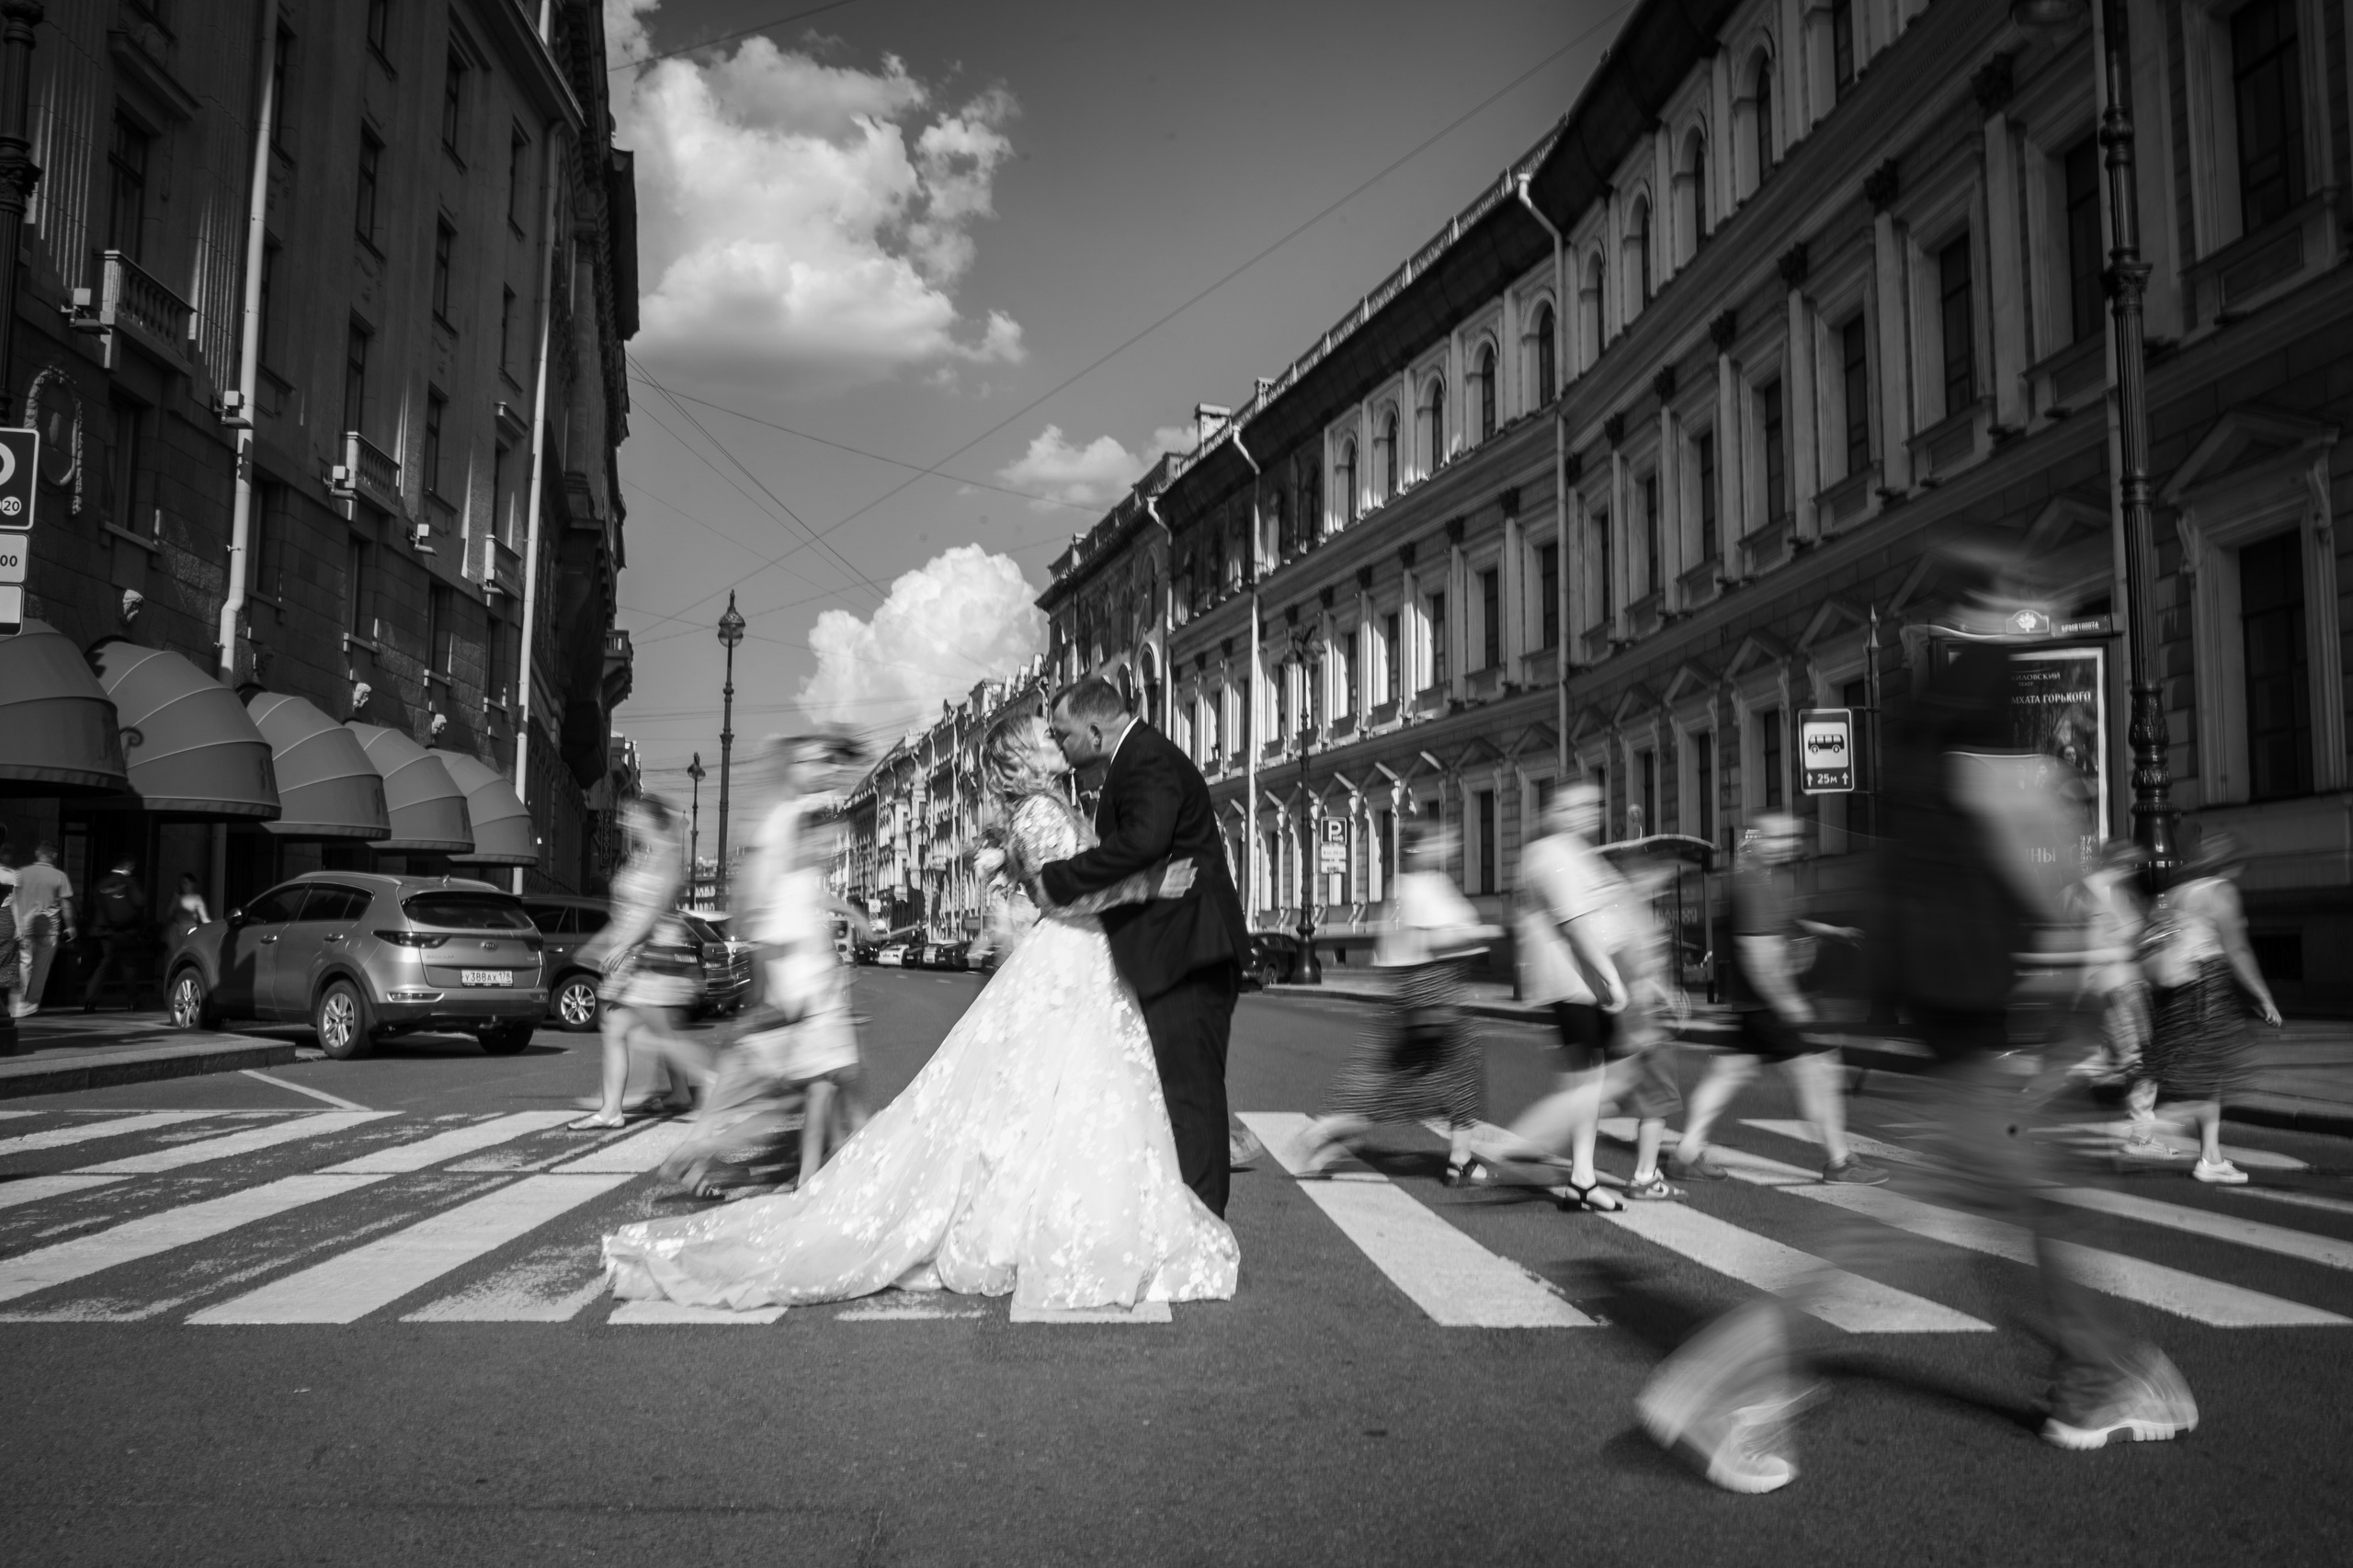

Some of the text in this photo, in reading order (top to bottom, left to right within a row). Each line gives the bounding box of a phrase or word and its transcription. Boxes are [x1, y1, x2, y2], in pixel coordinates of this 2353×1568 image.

[3, 500, 20, 512] 20
[2011, 690, 2091, 704] МХАТА ГОРЬКОГО
[1328, 821, 1342, 842] P
